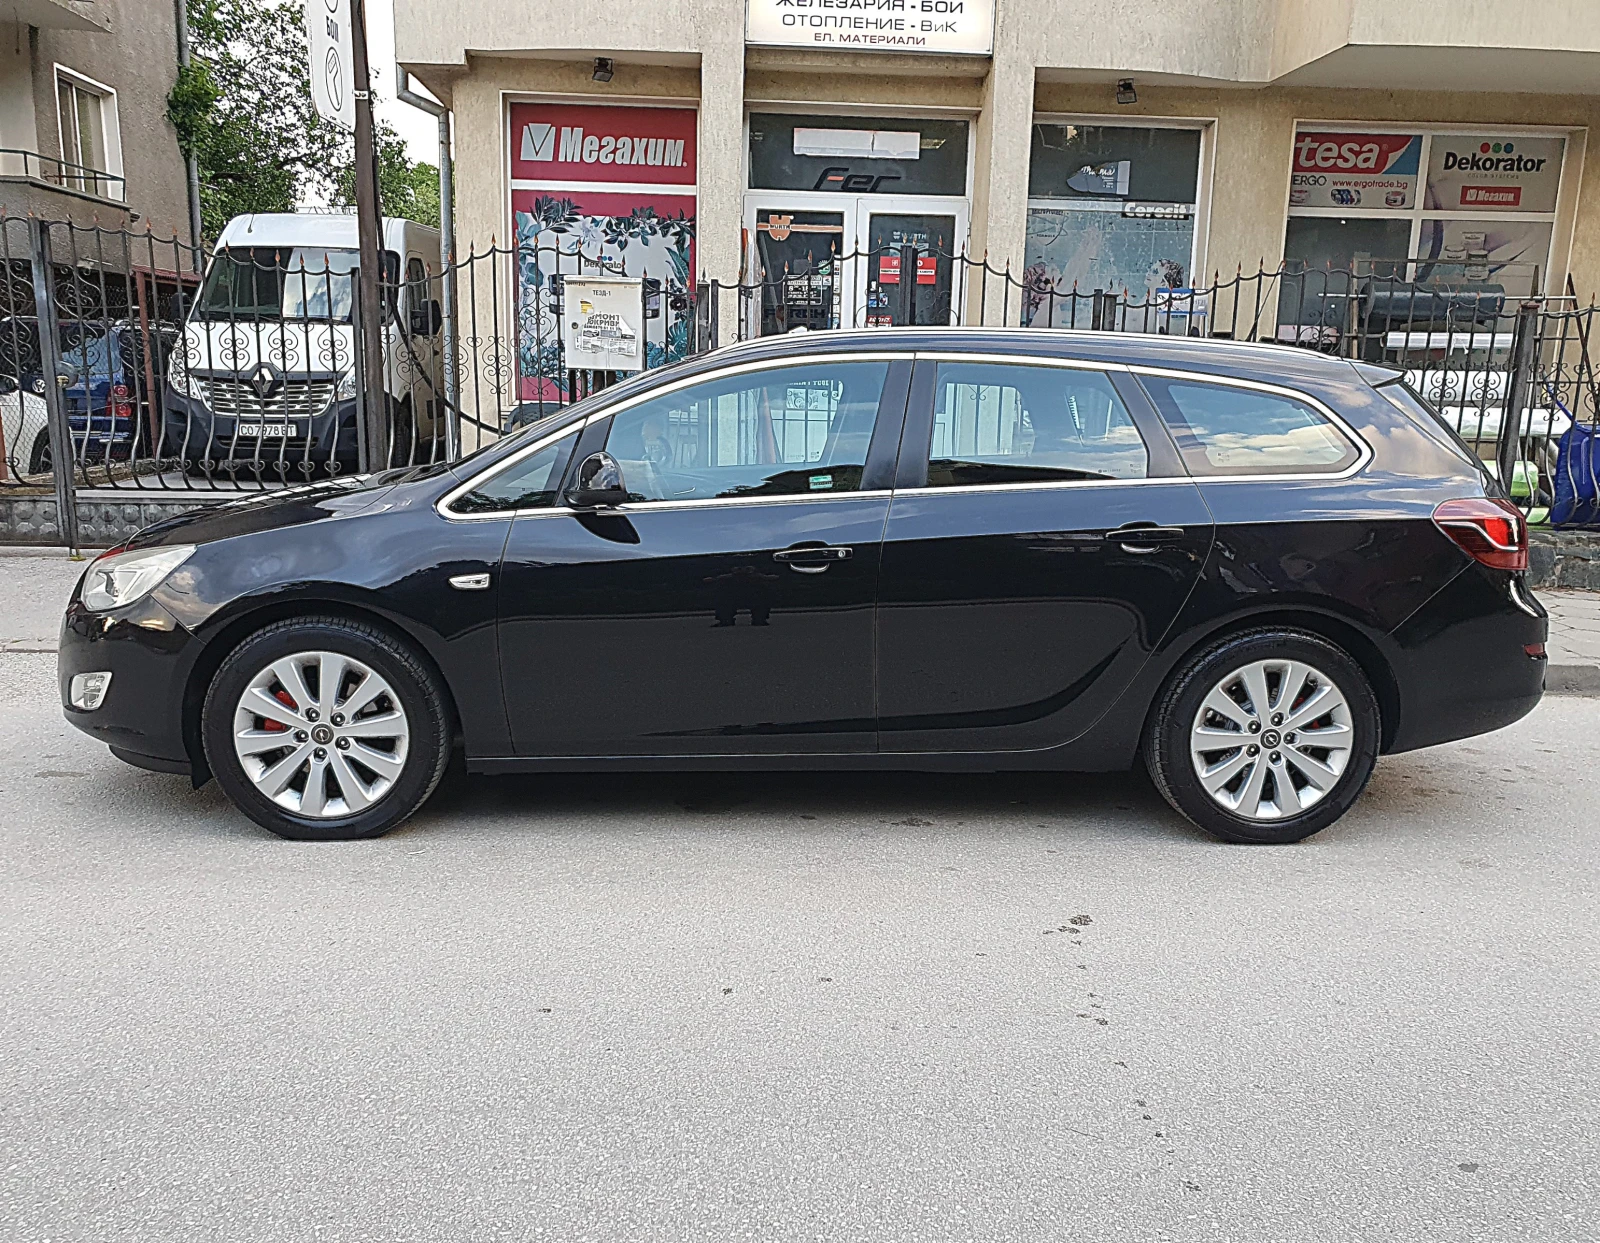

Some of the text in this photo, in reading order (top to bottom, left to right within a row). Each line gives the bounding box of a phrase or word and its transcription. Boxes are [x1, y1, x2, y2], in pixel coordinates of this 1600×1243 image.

[920, 1, 964, 14] БОИ
[782, 14, 905, 31] ОТОПЛЕНИЕ
[920, 20, 957, 33] ВиК
[839, 33, 926, 45] МАТЕРИАЛИ
[558, 126, 686, 167] Мегахим
[1295, 136, 1380, 169] tesa
[1443, 151, 1547, 172] Dekorator
[1292, 174, 1408, 190] ERGO www.ergotrade.bg
[1124, 202, 1187, 219] Ceresit
